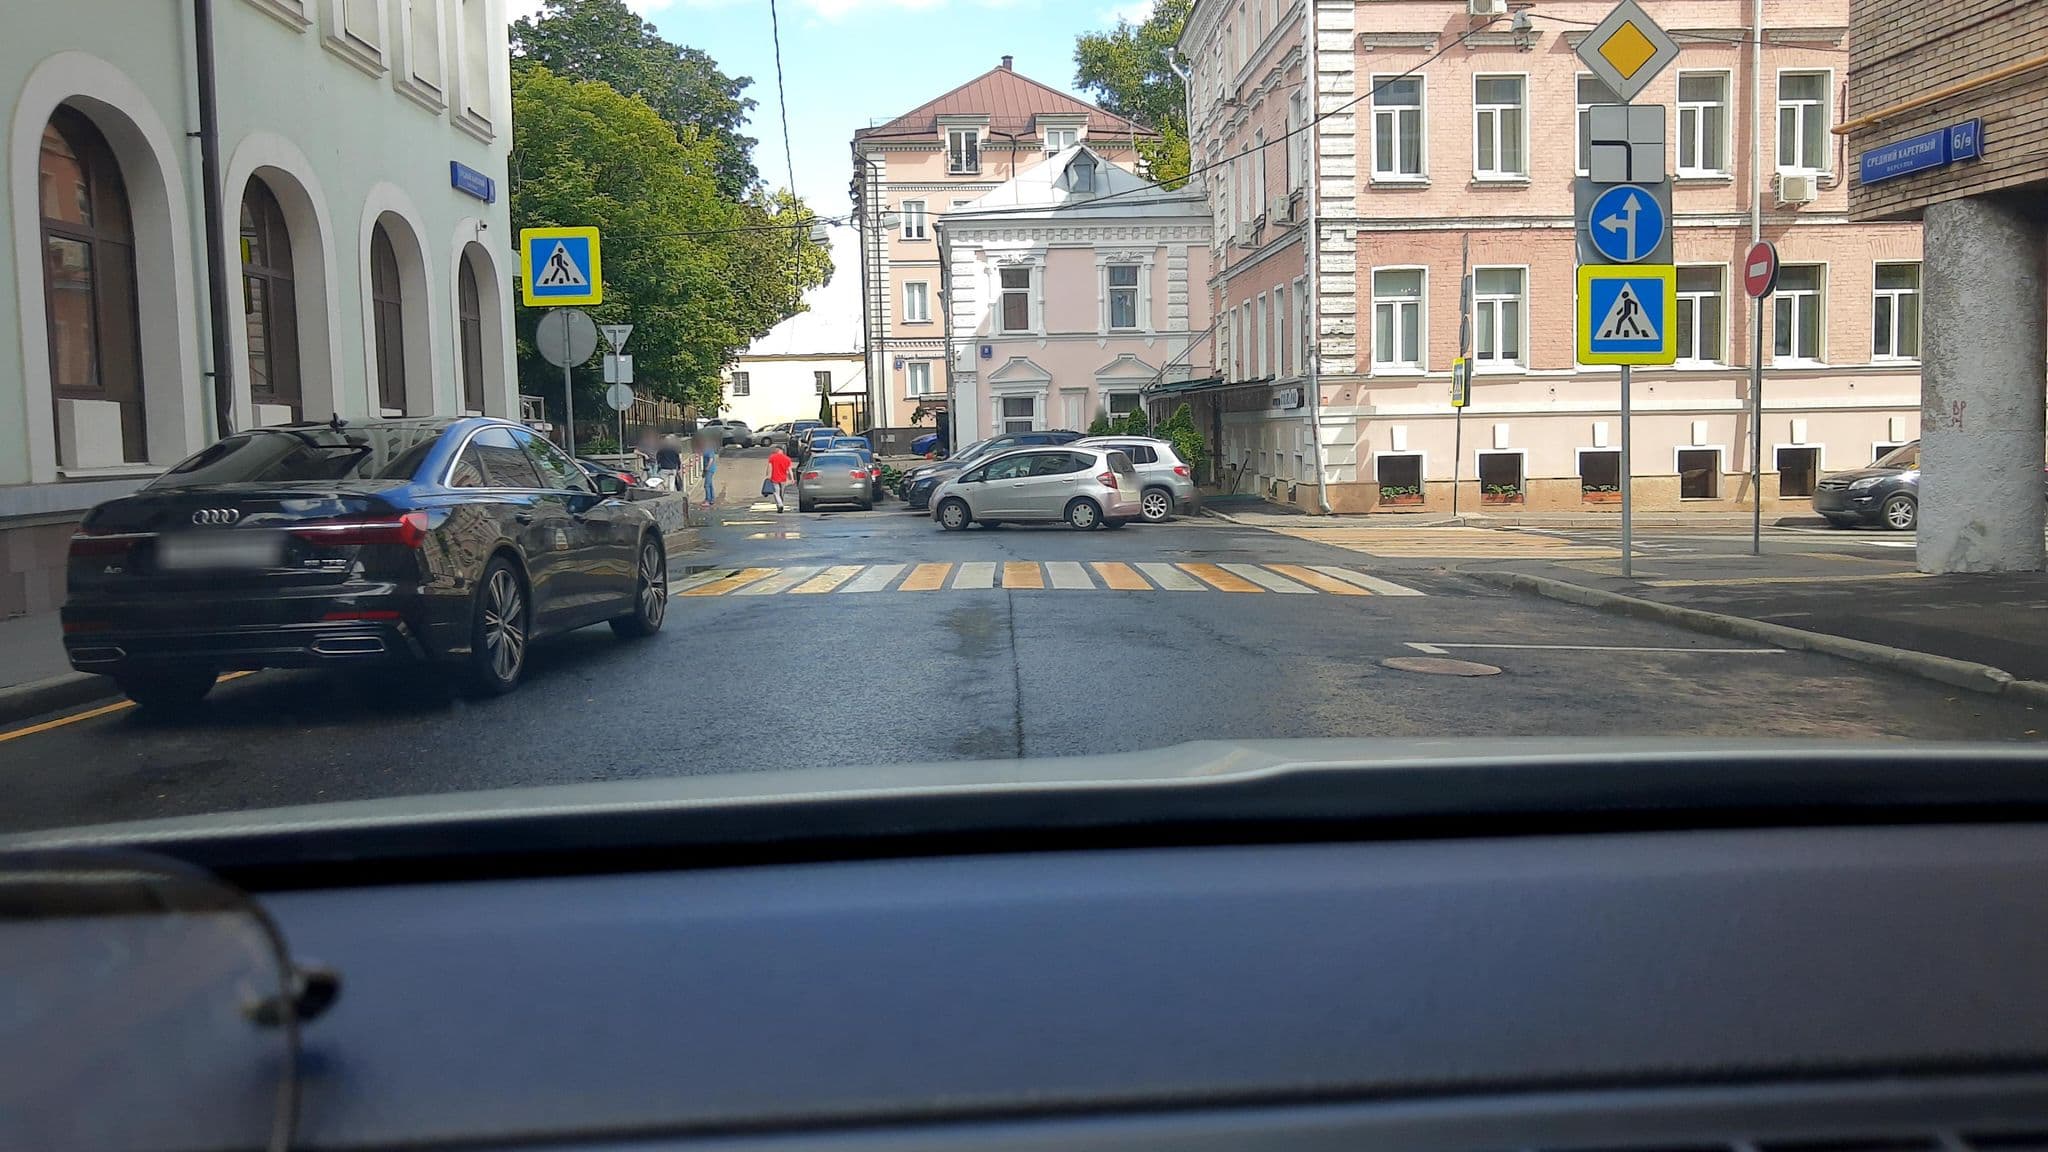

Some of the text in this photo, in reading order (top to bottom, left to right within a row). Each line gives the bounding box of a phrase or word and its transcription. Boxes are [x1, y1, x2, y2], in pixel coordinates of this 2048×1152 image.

[1953, 131, 1971, 150] 6/9
[1867, 138, 1936, 168] СРЕДНИЙ КАРЕТНЫЙ
